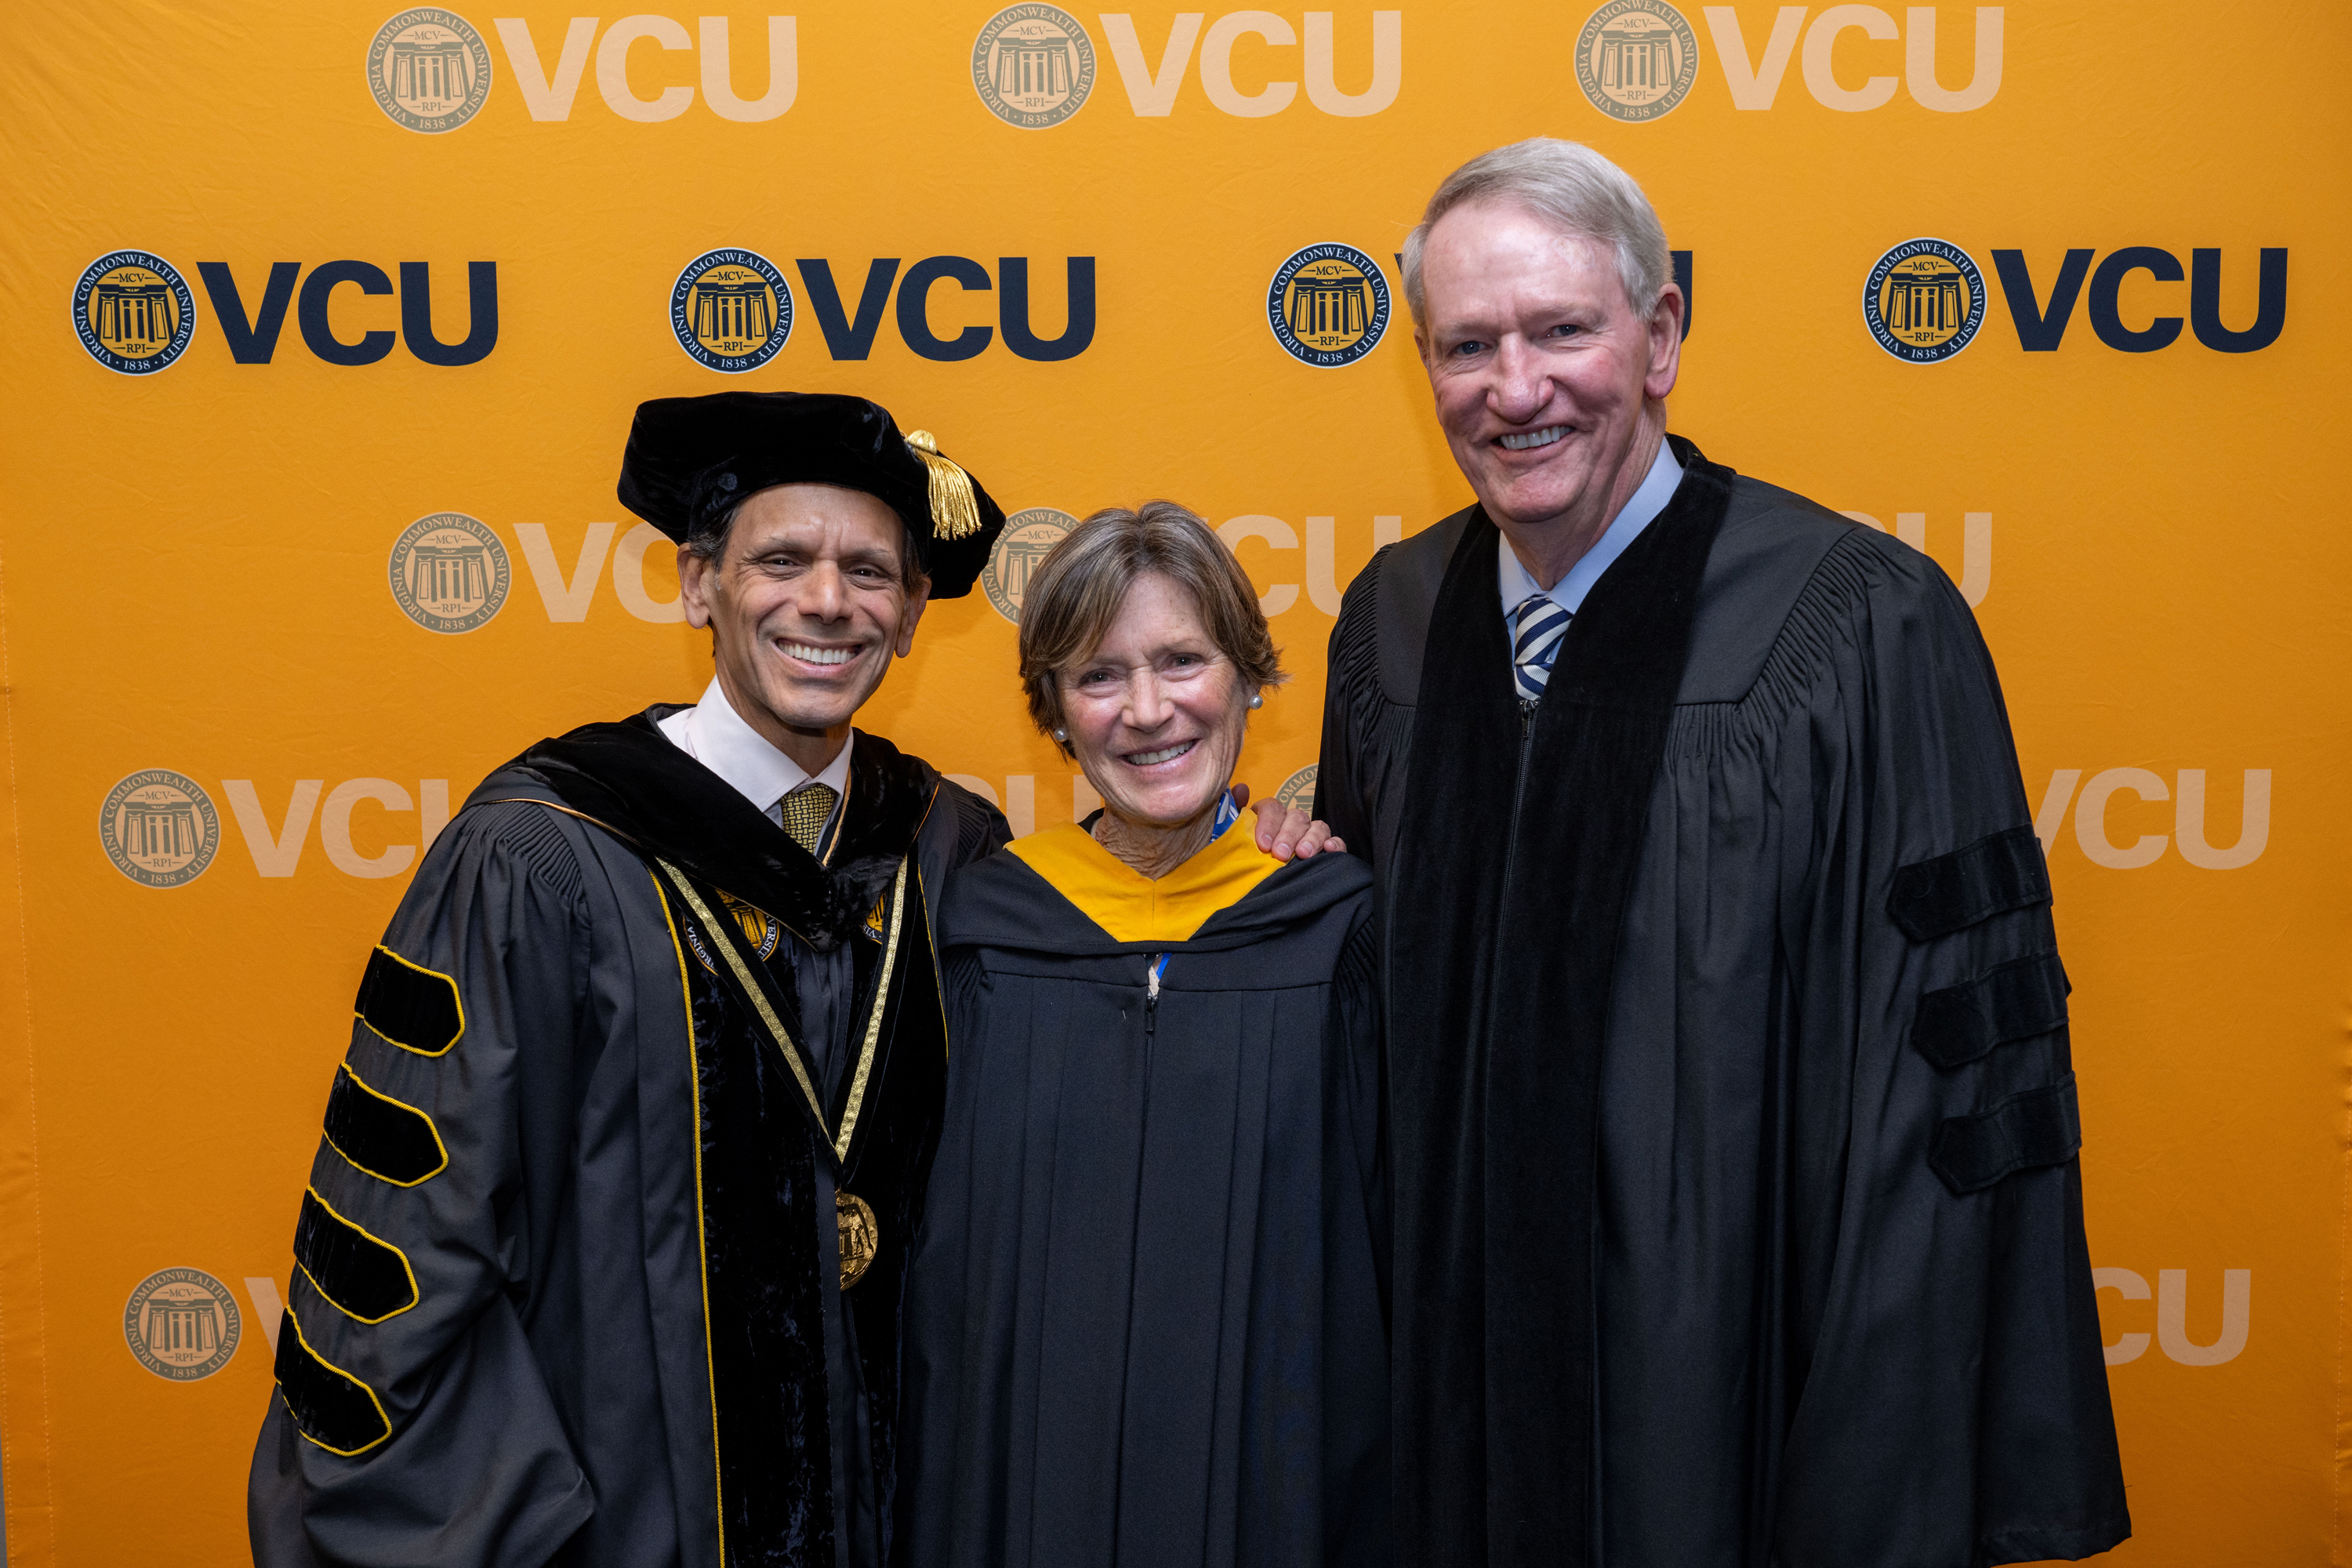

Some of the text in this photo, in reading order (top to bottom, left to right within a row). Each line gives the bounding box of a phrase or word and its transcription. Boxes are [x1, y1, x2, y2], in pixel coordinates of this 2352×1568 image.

[1623, 20, 1650, 29] MCV
[414, 31, 441, 41] MCV
[1019, 27, 1047, 36] MCV
[1577, 0, 1694, 112] VIRGINIA COMMONWEALTH UNIVERSITY
[1703, 4, 2004, 113] VCU
[372, 11, 488, 123] VIRGINIA COMMONWEALTH UNIVERSITY
[975, 6, 1092, 118] VIRGINIA COMMONWEALTH UNIVERSITY
[1099, 10, 1402, 118] VCU
[494, 14, 798, 122] VCU
[1627, 90, 1647, 100] RPI
[422, 102, 442, 112] RPI
[1025, 97, 1046, 107] RPI
[1624, 107, 1650, 118] 1838
[419, 118, 446, 129] 1838
[1022, 114, 1049, 124] 1838
[1275, 247, 1377, 294] COMMONWEALTH
[1316, 267, 1342, 276] MCV
[1912, 262, 1939, 271] MCV
[118, 274, 145, 283] MCV
[717, 272, 744, 281] MCV
[1866, 242, 1982, 353] VIRGINIA COMMONWEALTH UNIVERSITY
[1992, 247, 2288, 353] VCU
[77, 254, 192, 364] VIRGINIA COMMONWEALTH UNIVERSITY
[674, 252, 790, 362] VIRGINIA COMMONWEALTH UNIVERSITY
[797, 256, 1095, 361] VCU
[198, 260, 498, 366] VCU
[1355, 278, 1387, 356] UNIVERSITY
[1271, 299, 1305, 357] VIRGINIA
[1319, 336, 1340, 347] RPI
[1915, 332, 1935, 342] RPI
[126, 343, 147, 354] RPI
[724, 341, 744, 351] RPI
[1316, 352, 1343, 362] 1838
[1911, 348, 1938, 358] 1838
[124, 360, 151, 370] 1838
[720, 358, 747, 368] 1838
[435, 535, 462, 545] MCV
[1028, 531, 1054, 540] MCV
[393, 517, 507, 624] VIRGINIA COMMONWEALTH UNIVERSITY
[514, 522, 686, 624] VC
[984, 562, 1017, 619] VIRGINIA
[441, 604, 462, 613] RPI
[439, 619, 466, 630] 1838
[144, 792, 171, 800] MCV
[104, 773, 217, 878] VIRGINIA COMMONWEALTH UNIVERSITY
[153, 858, 172, 868] RPI
[151, 874, 176, 884] 1838
[129, 1271, 227, 1314] COMMONWEALTH
[169, 1289, 194, 1298] MCV
[208, 1299, 238, 1371] UNIVERSITY
[128, 1319, 160, 1372] VIRGINIA
[175, 1352, 194, 1362] RPI
[172, 1368, 198, 1377] 1838
